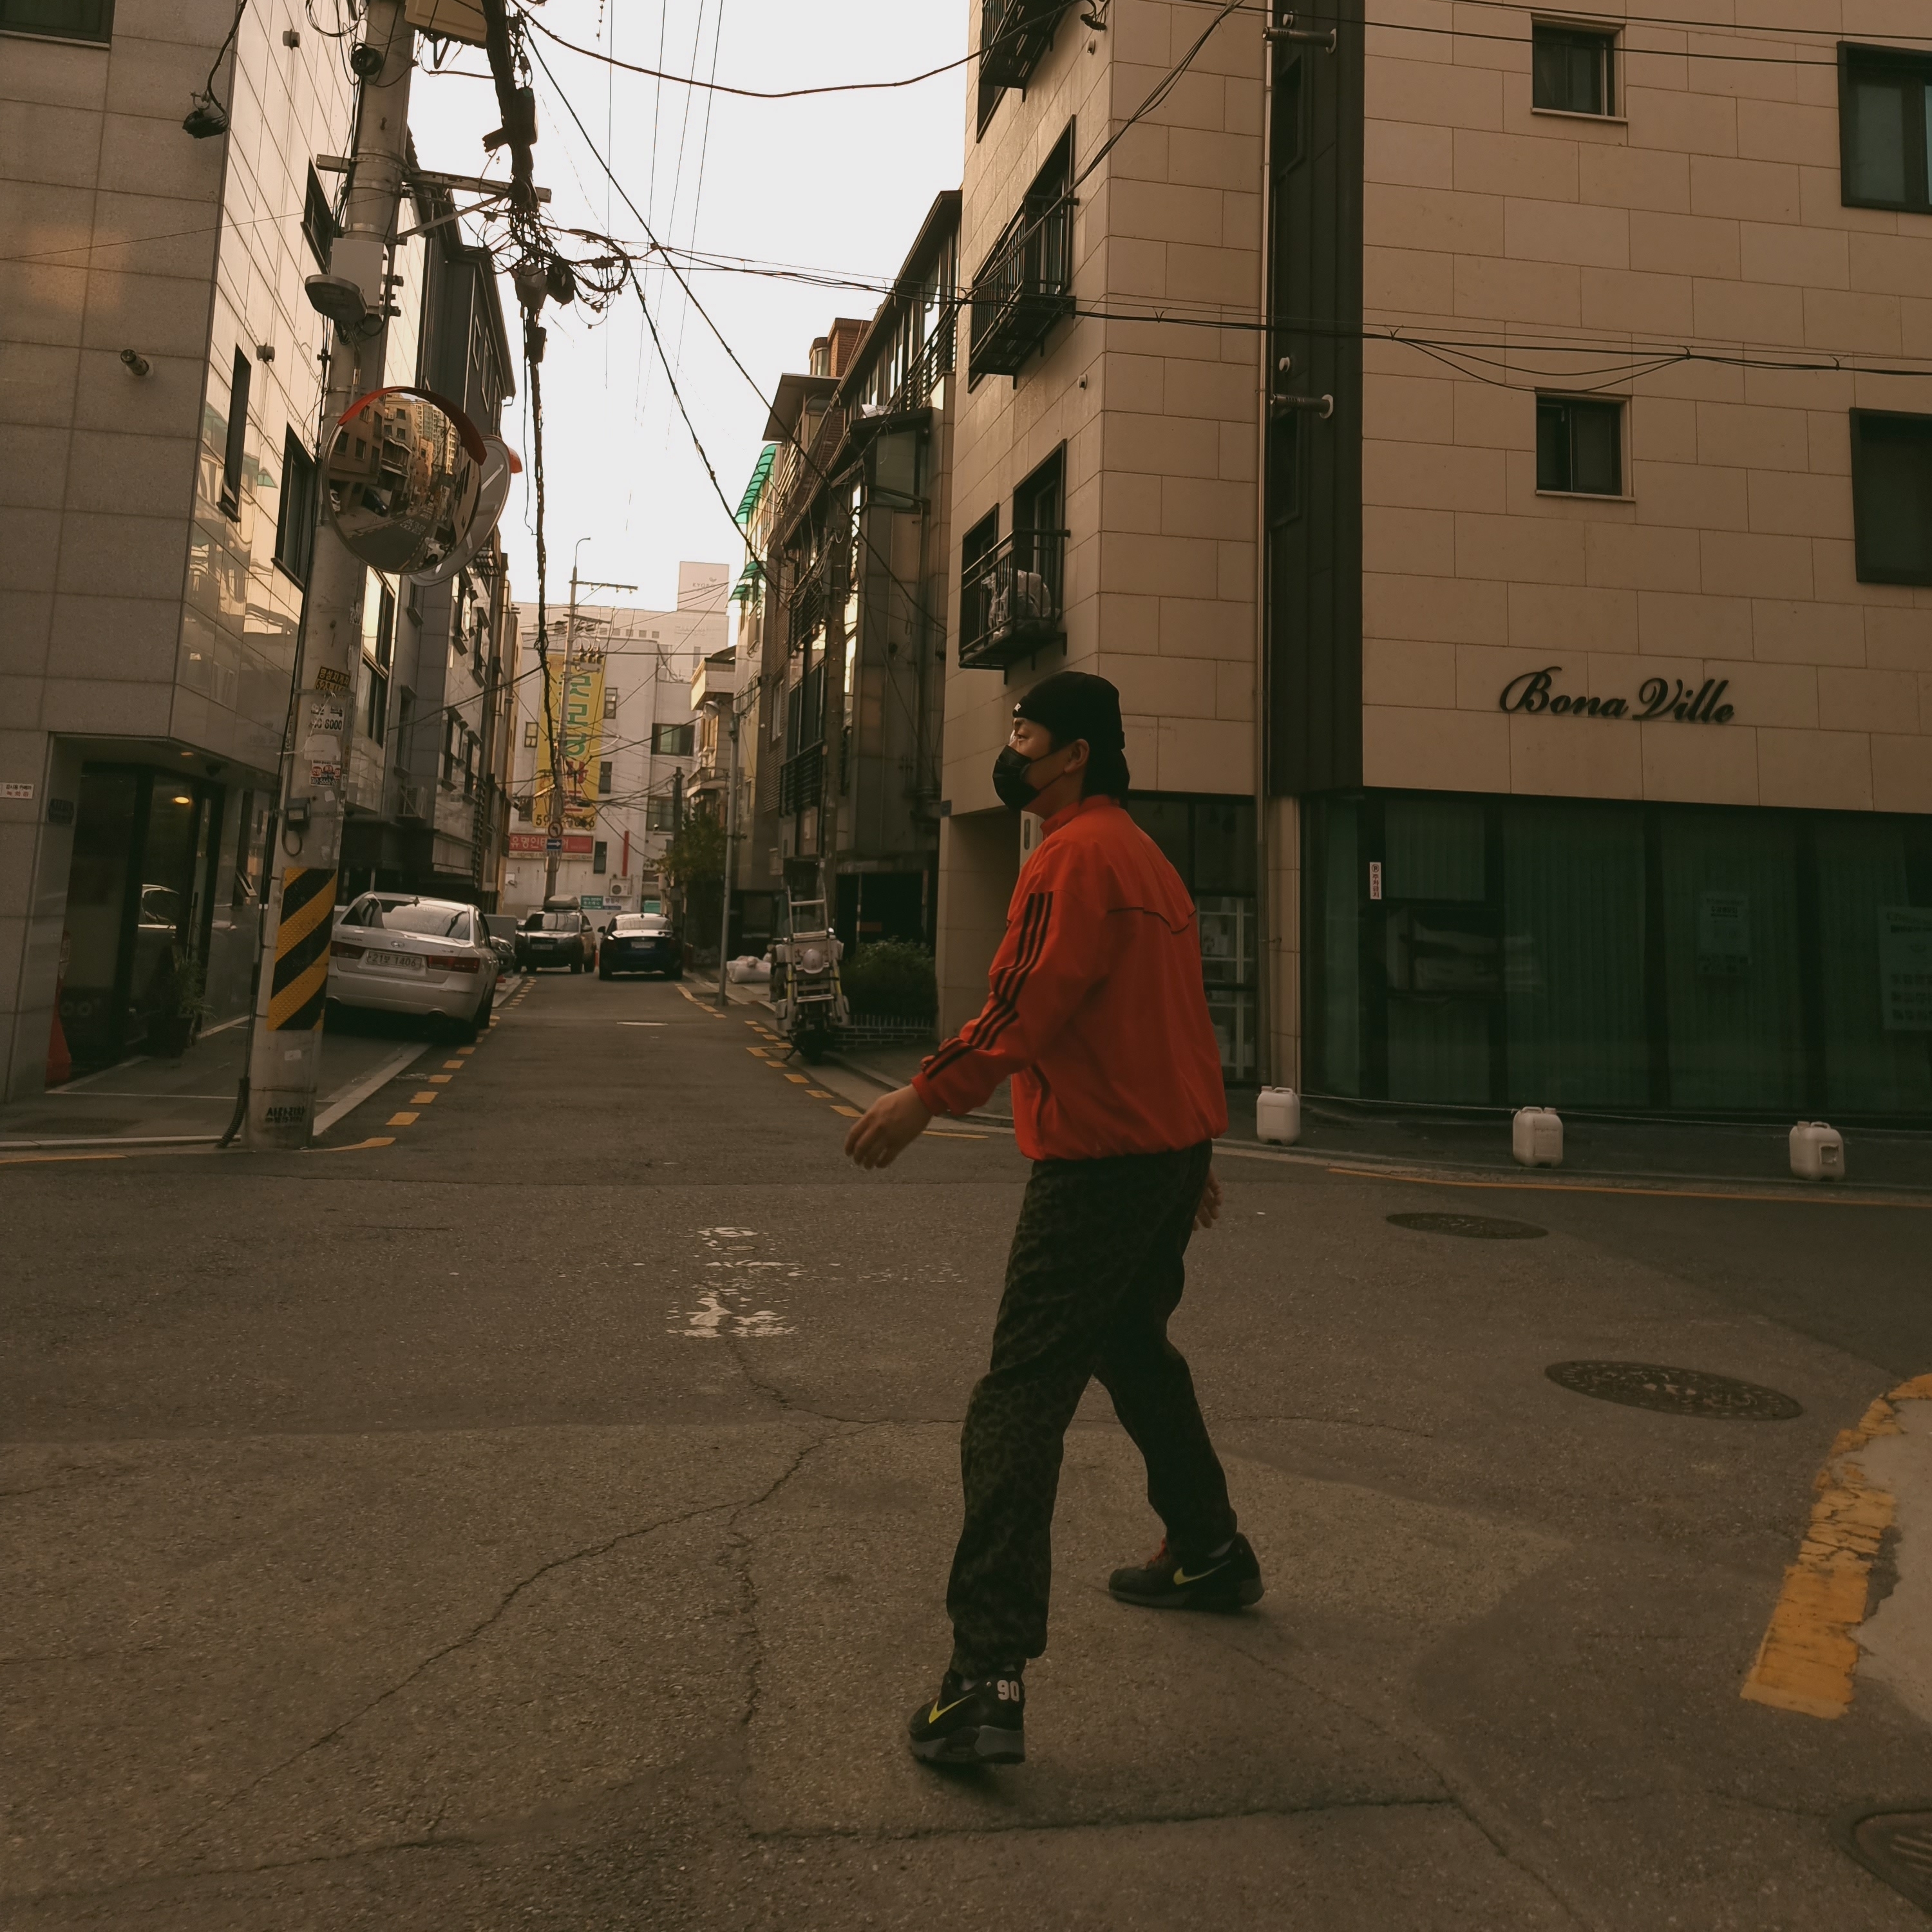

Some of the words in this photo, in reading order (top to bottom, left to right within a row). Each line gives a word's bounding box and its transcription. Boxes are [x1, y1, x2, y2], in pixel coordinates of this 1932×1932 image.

[1499, 666, 1629, 717] Bona
[1632, 677, 1734, 723] Ville
[395, 956, 416, 967] 1406
[997, 1680, 1019, 1701] 90
